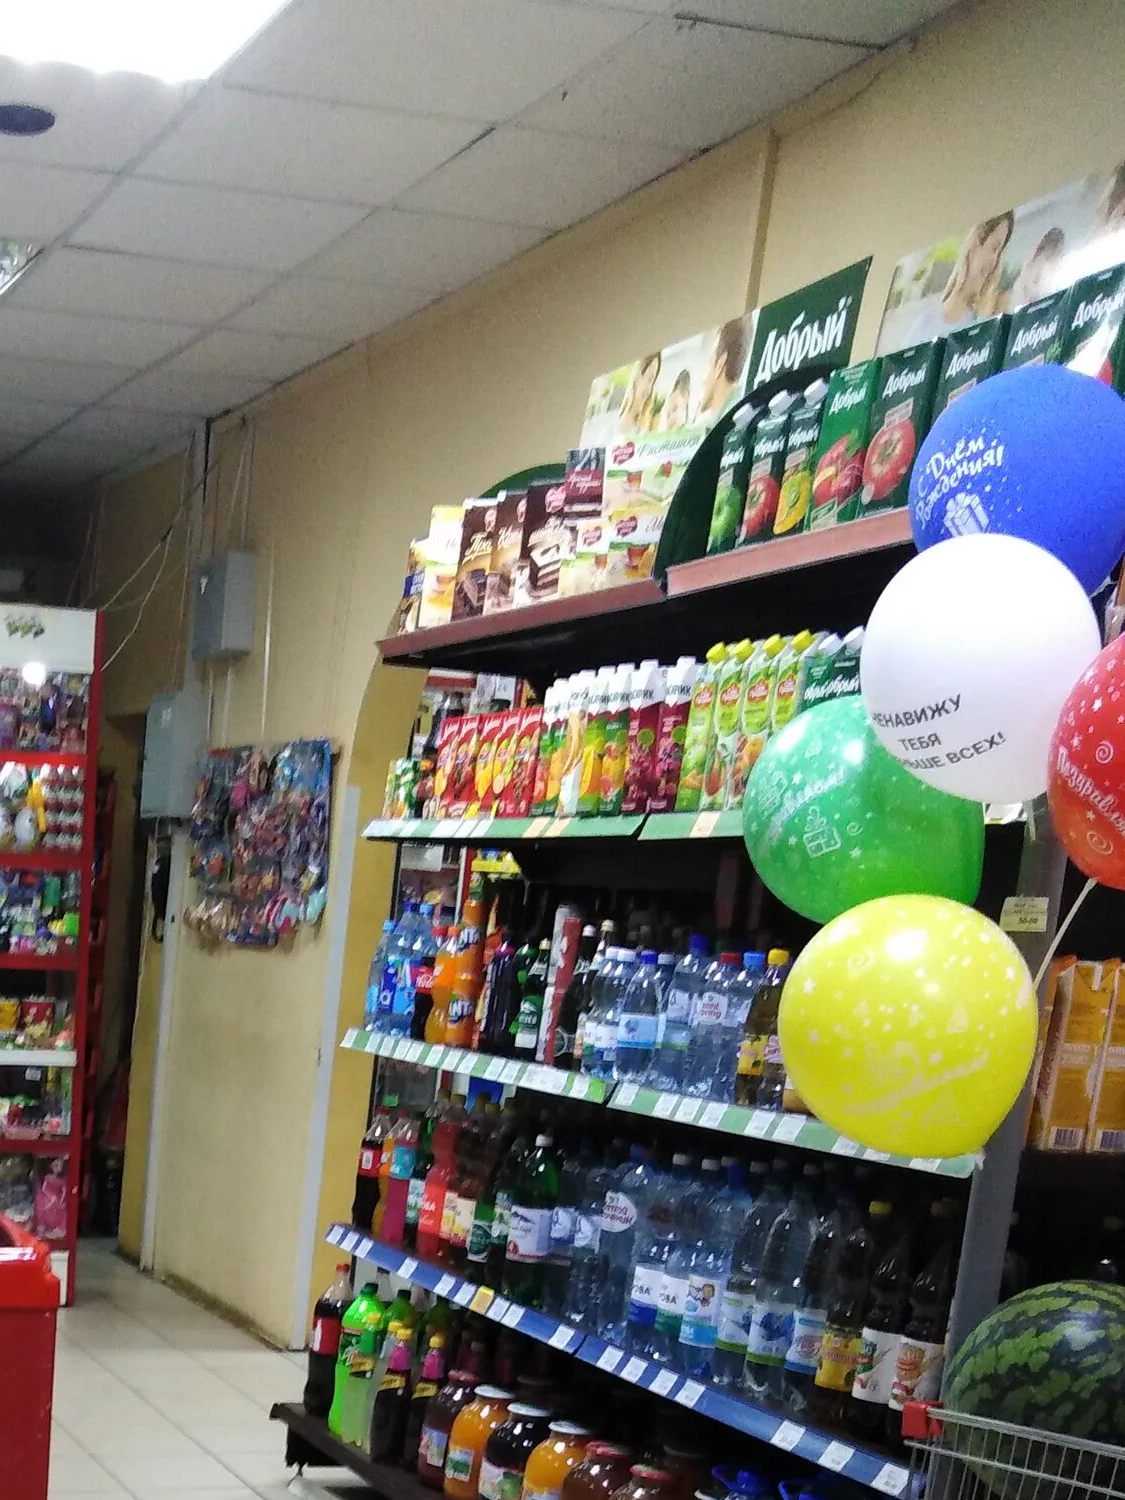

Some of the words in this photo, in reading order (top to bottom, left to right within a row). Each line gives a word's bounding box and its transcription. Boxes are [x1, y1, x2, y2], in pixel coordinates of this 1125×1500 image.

[752, 295, 853, 391] Добрый
[1010, 313, 1061, 357] Добрый
[882, 360, 929, 400] Добрый
[944, 340, 991, 381] Добрый
[829, 380, 868, 417] Добрый
[925, 435, 985, 480] Днём
[897, 732, 942, 752] ТЕБЯ
[946, 730, 1007, 765] ВСЕХ!
